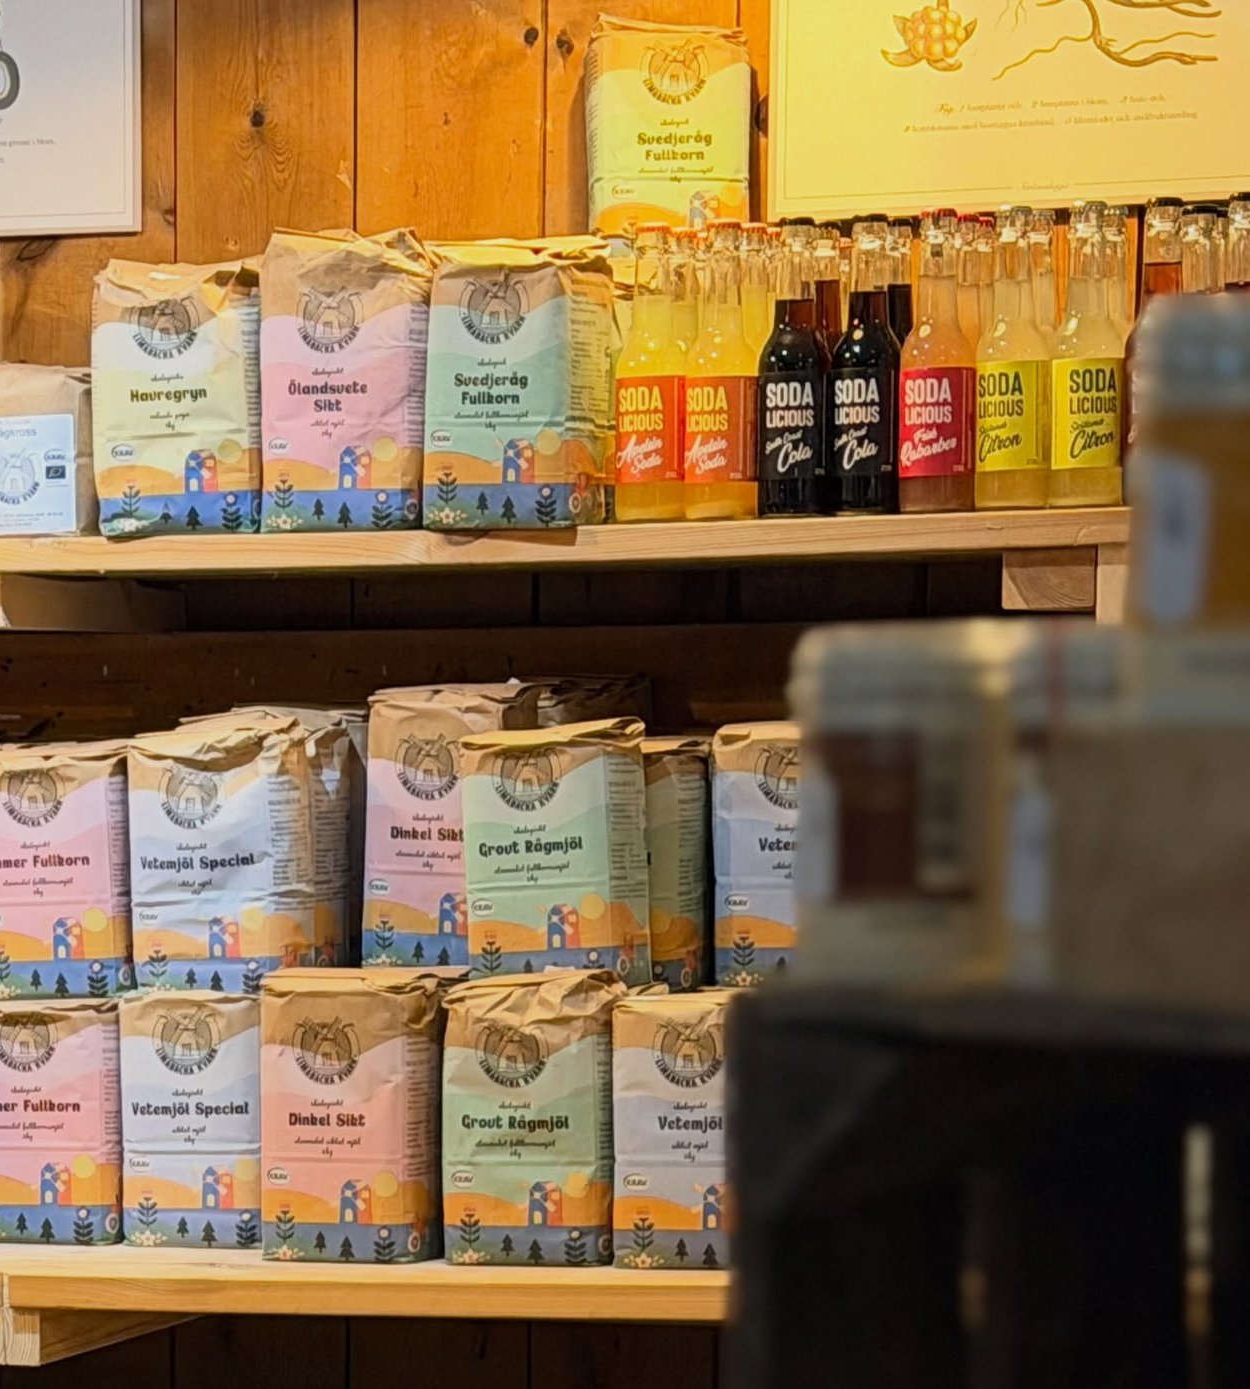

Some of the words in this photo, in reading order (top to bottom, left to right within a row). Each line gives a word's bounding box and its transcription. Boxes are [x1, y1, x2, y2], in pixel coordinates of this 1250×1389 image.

[637, 131, 713, 147] Svedjeråg
[645, 149, 705, 161] Fullkorn
[288, 379, 368, 396] Ölandsvete
[454, 371, 529, 390] Svedjeråg
[978, 371, 1024, 398] SODA
[1069, 367, 1117, 393] SODA
[130, 388, 208, 404] Havregryn
[461, 391, 520, 406] Fullkorn
[619, 385, 663, 412] SODA
[686, 385, 728, 412] SODA
[765, 382, 814, 408] SODA
[834, 377, 880, 405] SODA
[904, 377, 952, 405] SODA
[314, 399, 343, 413] Sikt
[834, 405, 880, 425] LICIOUS
[978, 399, 1024, 419] LICIOUS
[1069, 395, 1117, 415] LICIOUS
[619, 412, 664, 433] LICIOUS
[686, 413, 728, 433] LICIOUS
[765, 409, 815, 429] LICIOUS
[904, 405, 953, 426] LICIOUS
[842, 438, 880, 470] Cola
[978, 432, 1023, 463] Citron
[1070, 429, 1115, 459] Citron
[631, 452, 664, 474] Soda
[695, 452, 728, 475] Soda
[777, 443, 814, 473] Cola
[390, 826, 432, 842] Dinkel
[437, 827, 464, 842] Sikt
[479, 841, 520, 857] Grovt
[524, 836, 583, 856] Rågmjöl
[759, 837, 797, 852] Vete
[32, 854, 90, 868] Fullkorn
[140, 855, 194, 873] Vetemjöl
[199, 853, 255, 871] Special
[23, 1099, 81, 1113] Fullkorn
[131, 1102, 190, 1118] Vetemjöl
[195, 1101, 249, 1118] Special
[288, 1112, 331, 1127] Dinkel
[336, 1112, 366, 1127] Sikt
[461, 1114, 503, 1130] Grovt
[508, 1114, 570, 1133] Rågmjöl
[658, 1115, 724, 1133] Vetemjöl
